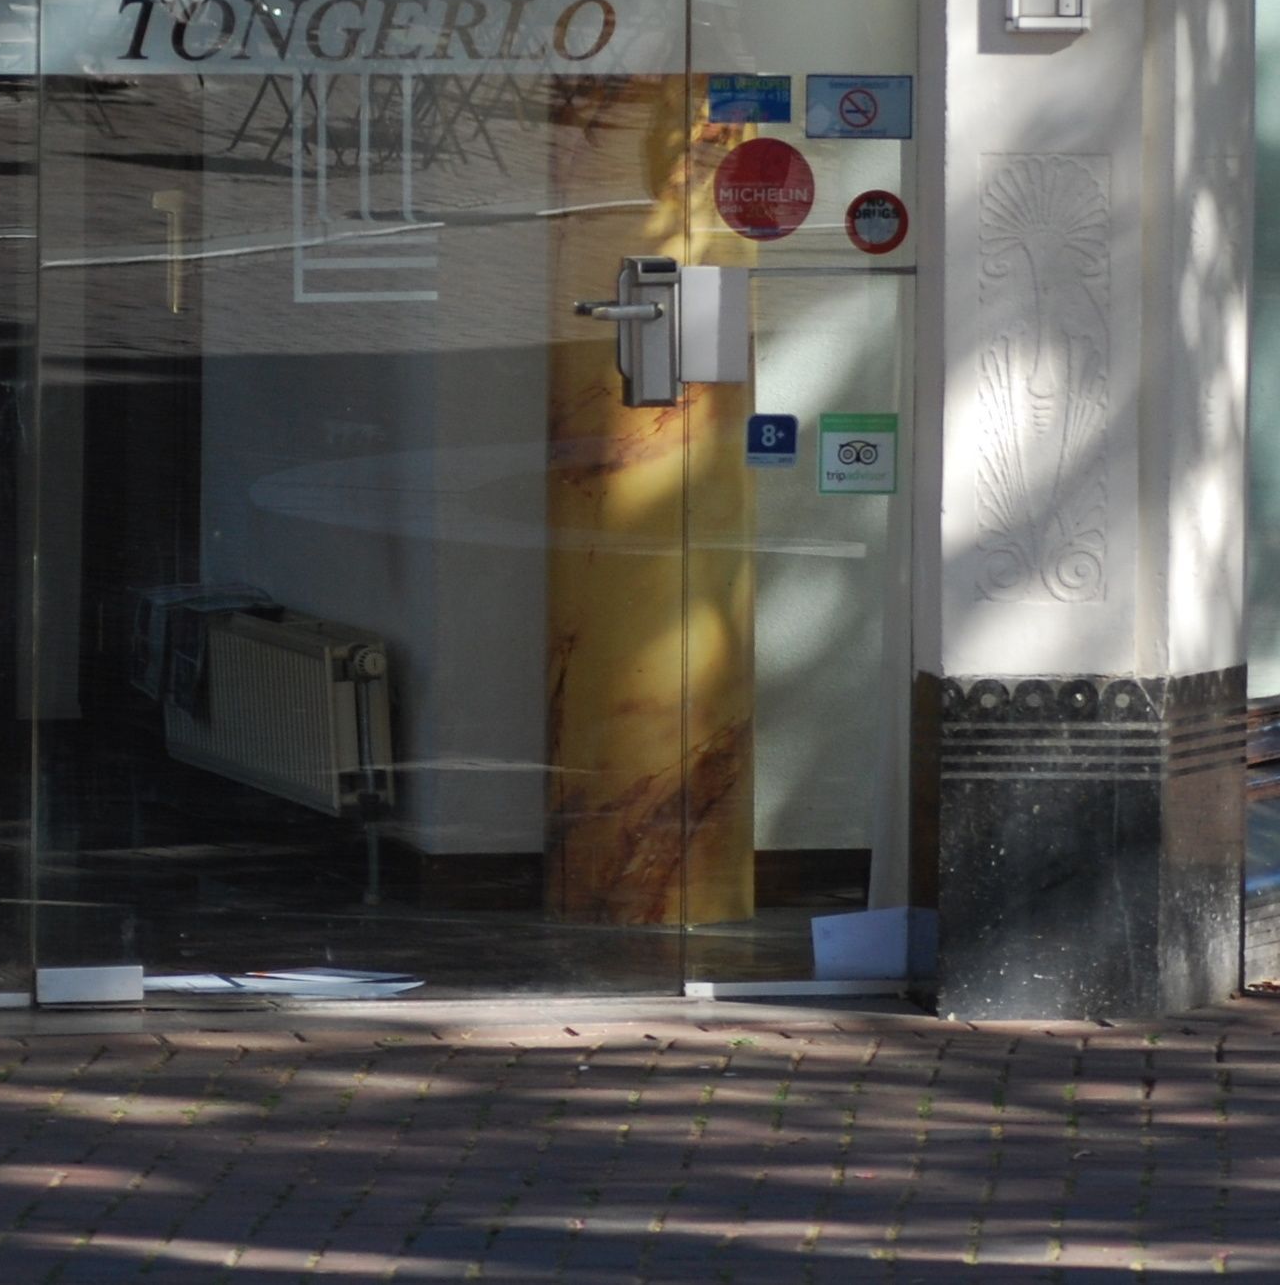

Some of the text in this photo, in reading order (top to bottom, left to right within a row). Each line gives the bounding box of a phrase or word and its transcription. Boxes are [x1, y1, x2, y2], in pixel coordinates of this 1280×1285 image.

[719, 187, 809, 204] MICHELIN
[866, 198, 886, 207] NO
[853, 207, 900, 220] DRUGS
[826, 470, 887, 483] tripadvisor
